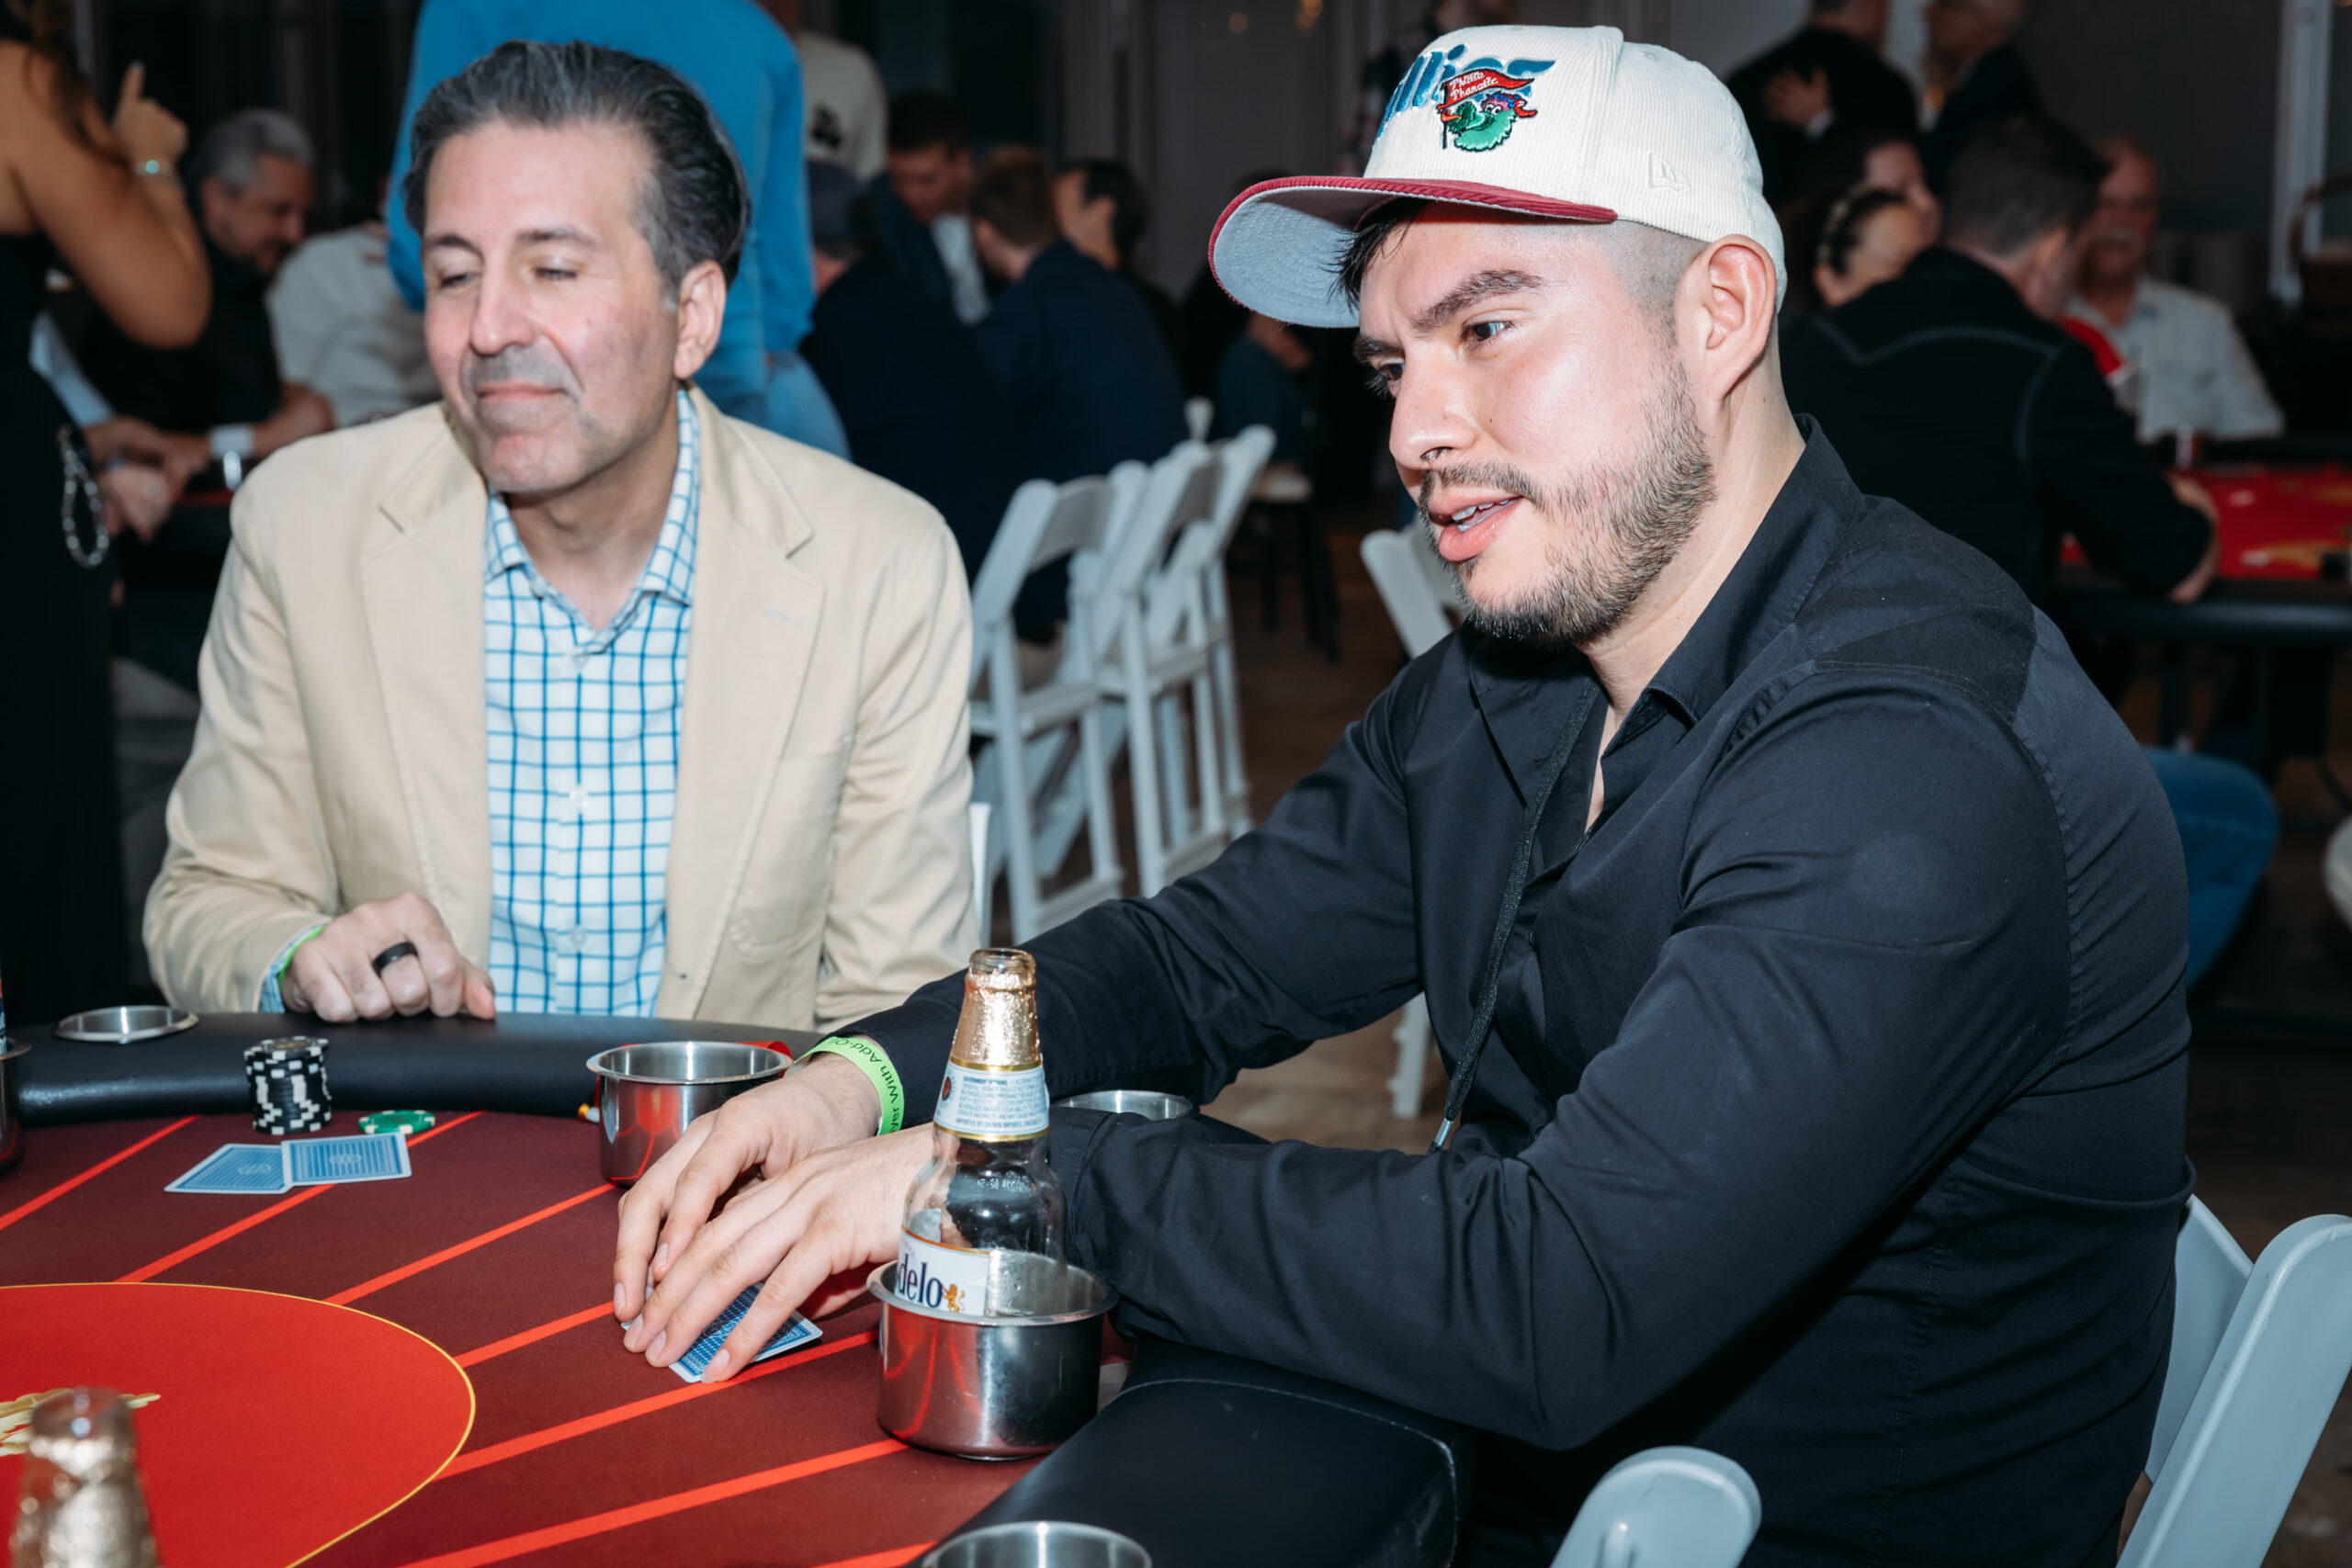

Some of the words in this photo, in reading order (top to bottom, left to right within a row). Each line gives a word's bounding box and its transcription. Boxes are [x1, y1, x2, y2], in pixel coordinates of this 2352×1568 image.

[1451, 76, 1499, 100] Phanatic
[879, 1066, 899, 1103] With
[888, 1107, 900, 1133] yer
